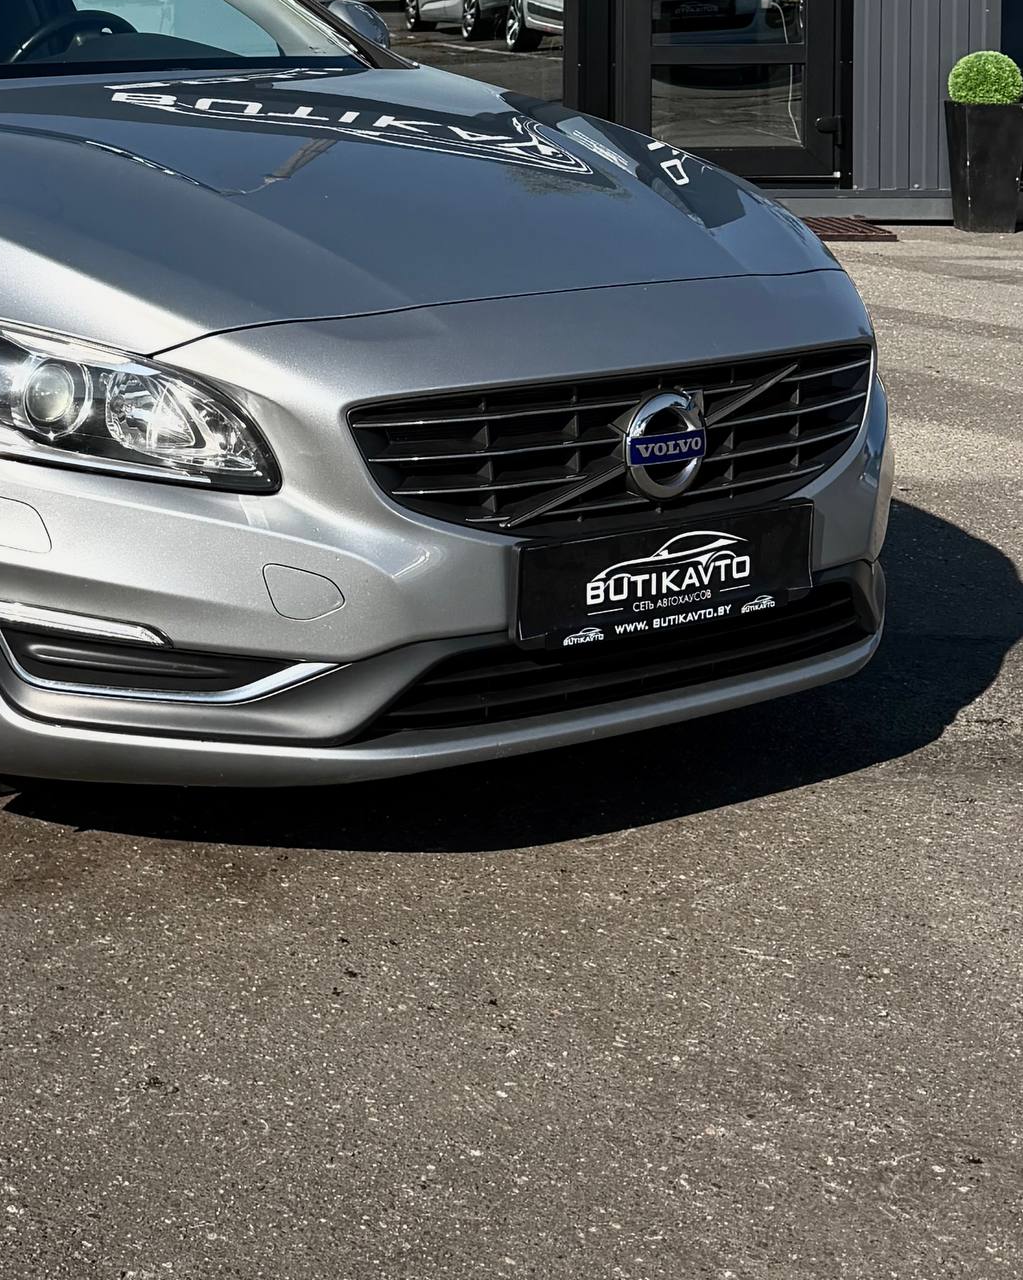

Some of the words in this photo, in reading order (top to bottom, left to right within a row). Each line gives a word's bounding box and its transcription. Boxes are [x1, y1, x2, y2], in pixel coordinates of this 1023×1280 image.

[635, 436, 702, 458] VOLVO
[586, 554, 750, 606] BUTIKAVTO
[632, 600, 655, 612] СЕТЬ
[656, 589, 712, 608] АВТОХАУСОВ
[614, 620, 649, 634] WWW.
[653, 604, 732, 629] BUTIKAVTO.BY
[563, 632, 605, 646] BUTIKAVTO
